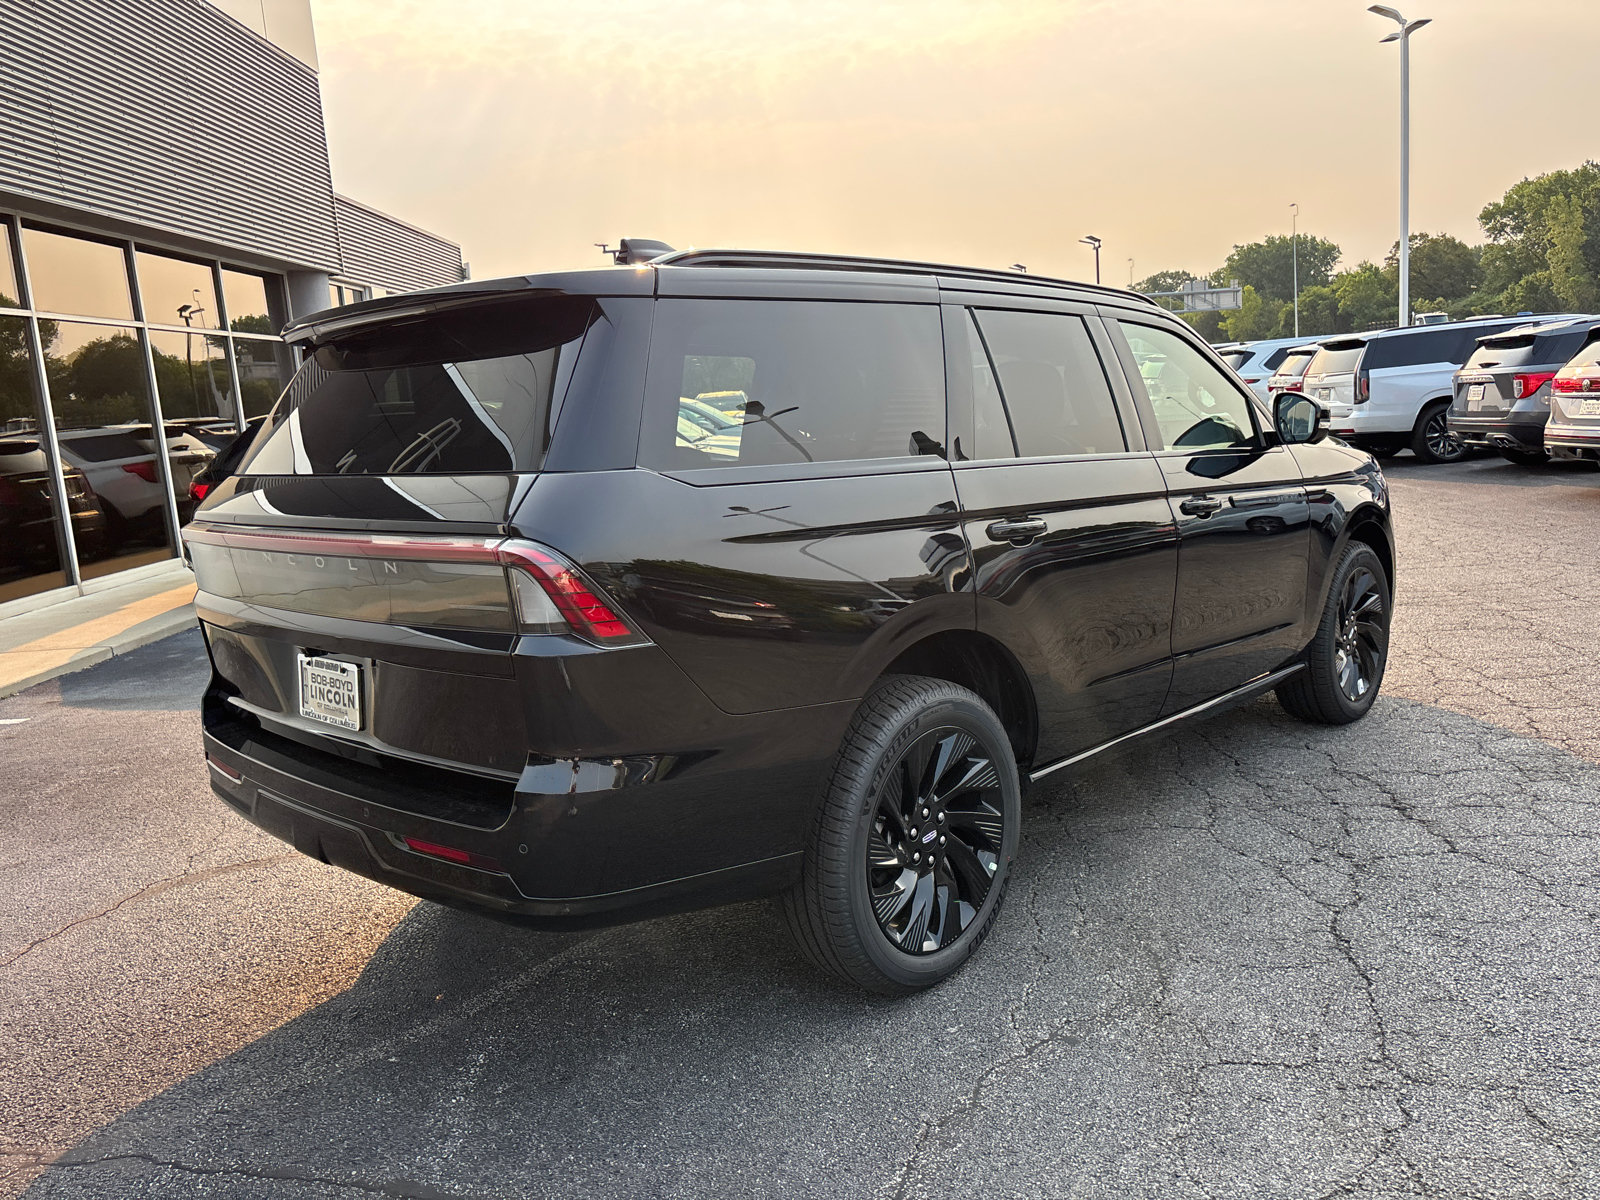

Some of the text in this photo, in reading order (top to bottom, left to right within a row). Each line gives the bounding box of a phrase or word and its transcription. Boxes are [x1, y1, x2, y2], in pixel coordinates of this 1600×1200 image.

[311, 673, 353, 692] BOB-BOYD
[310, 685, 355, 709] LINCOLN
[302, 709, 322, 720] LINCOLN
[322, 714, 329, 722] OF
[329, 717, 357, 729] COLUMBUS
[873, 719, 919, 791] MICHELIN
